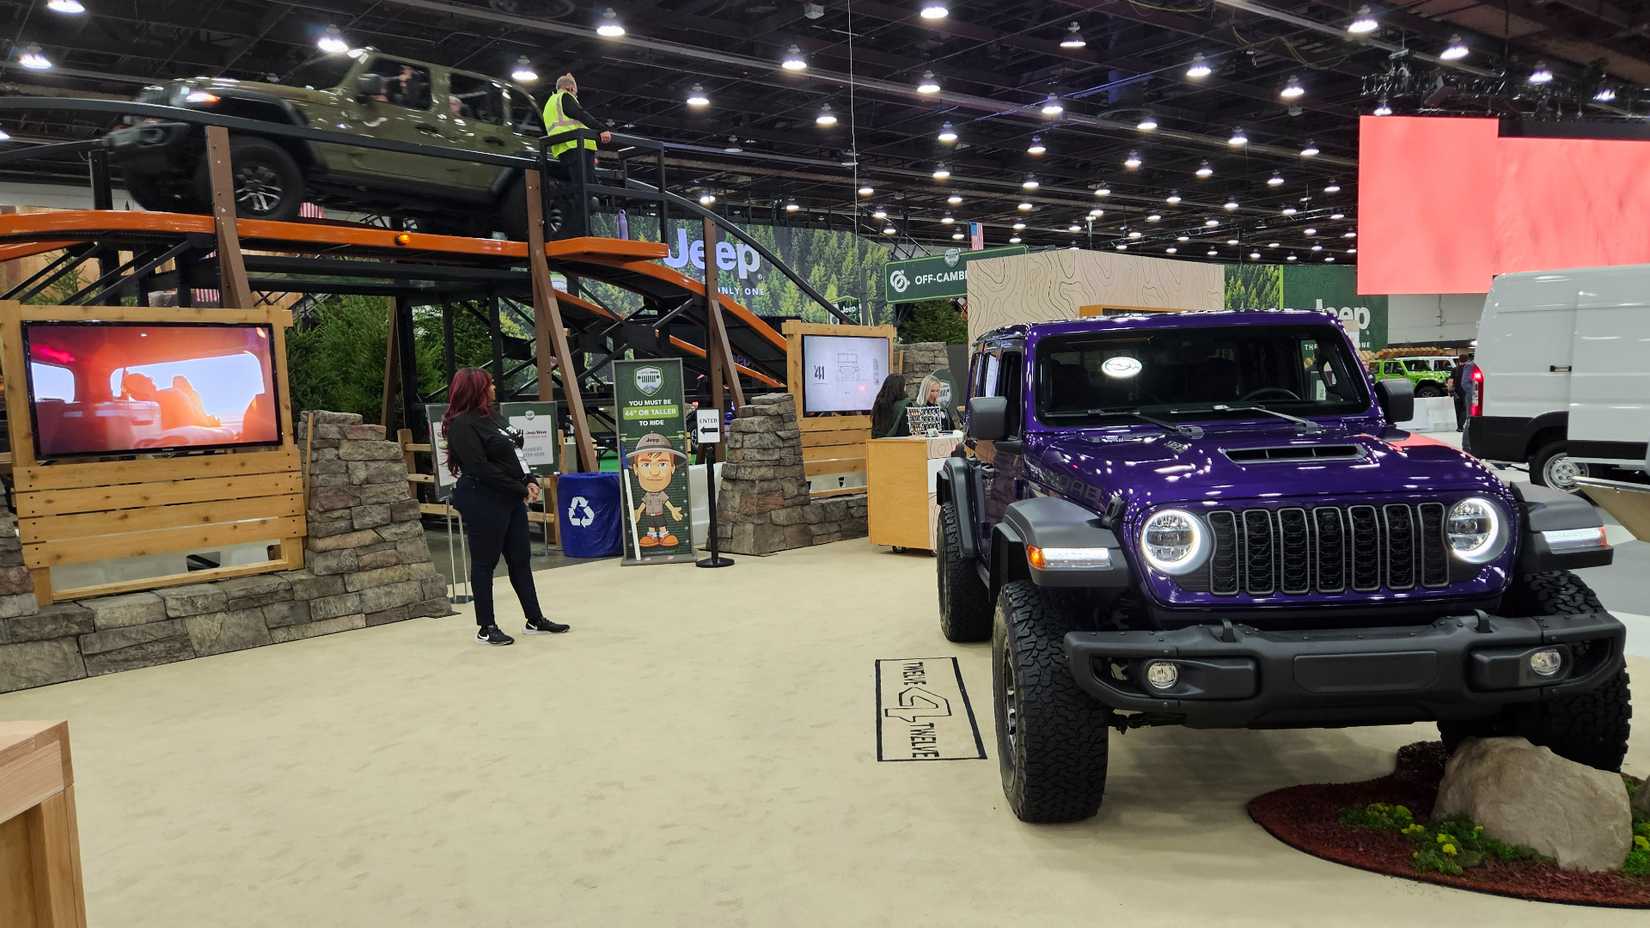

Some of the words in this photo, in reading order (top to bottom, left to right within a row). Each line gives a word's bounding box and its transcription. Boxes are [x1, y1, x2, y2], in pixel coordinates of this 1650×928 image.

[663, 228, 761, 279] Jeep
[914, 270, 967, 285] OFF-CAMB
[717, 287, 740, 296] NLY
[744, 287, 765, 296] ONE
[903, 662, 926, 685] TWELVE
[910, 723, 939, 757] TWELVE
